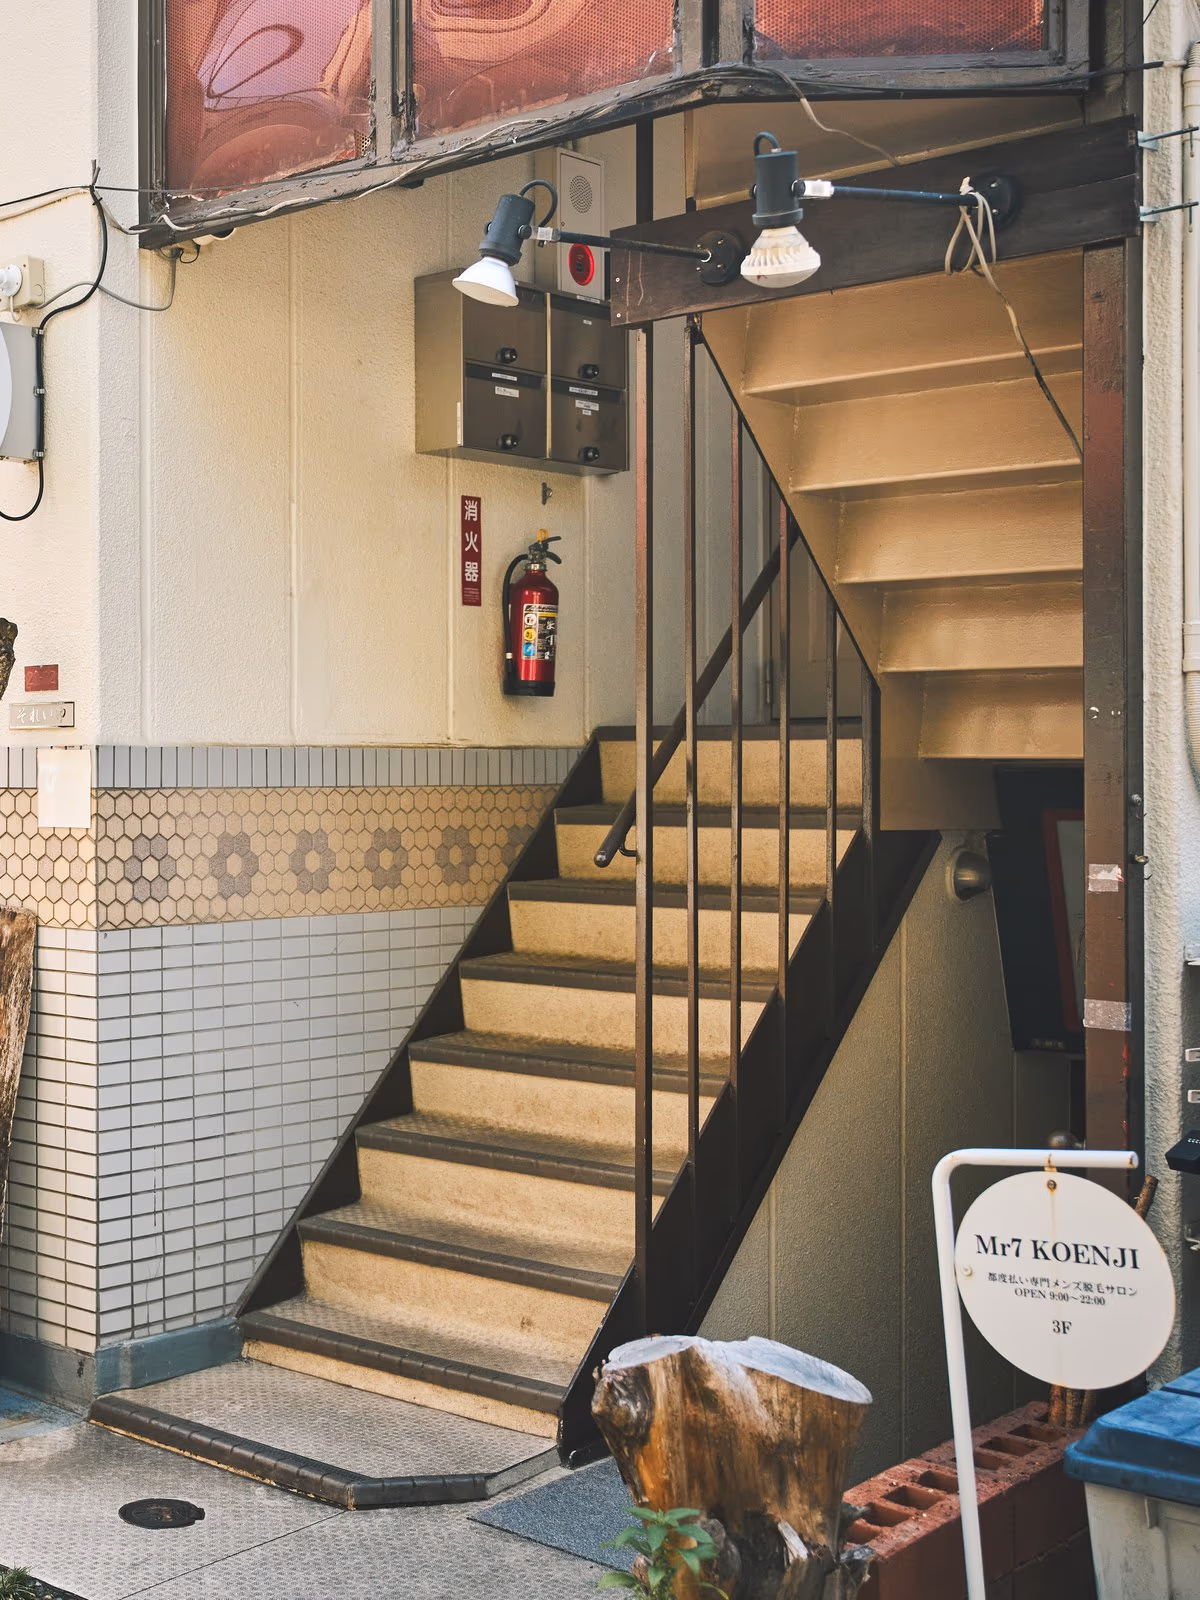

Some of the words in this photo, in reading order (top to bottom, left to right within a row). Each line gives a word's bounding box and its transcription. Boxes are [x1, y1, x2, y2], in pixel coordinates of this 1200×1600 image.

[464, 499, 479, 582] 消火器
[974, 1234, 1023, 1259] Mr7
[1031, 1239, 1141, 1270] KOENJI
[1014, 1287, 1047, 1300] OPEN
[1052, 1320, 1073, 1335] 3F
